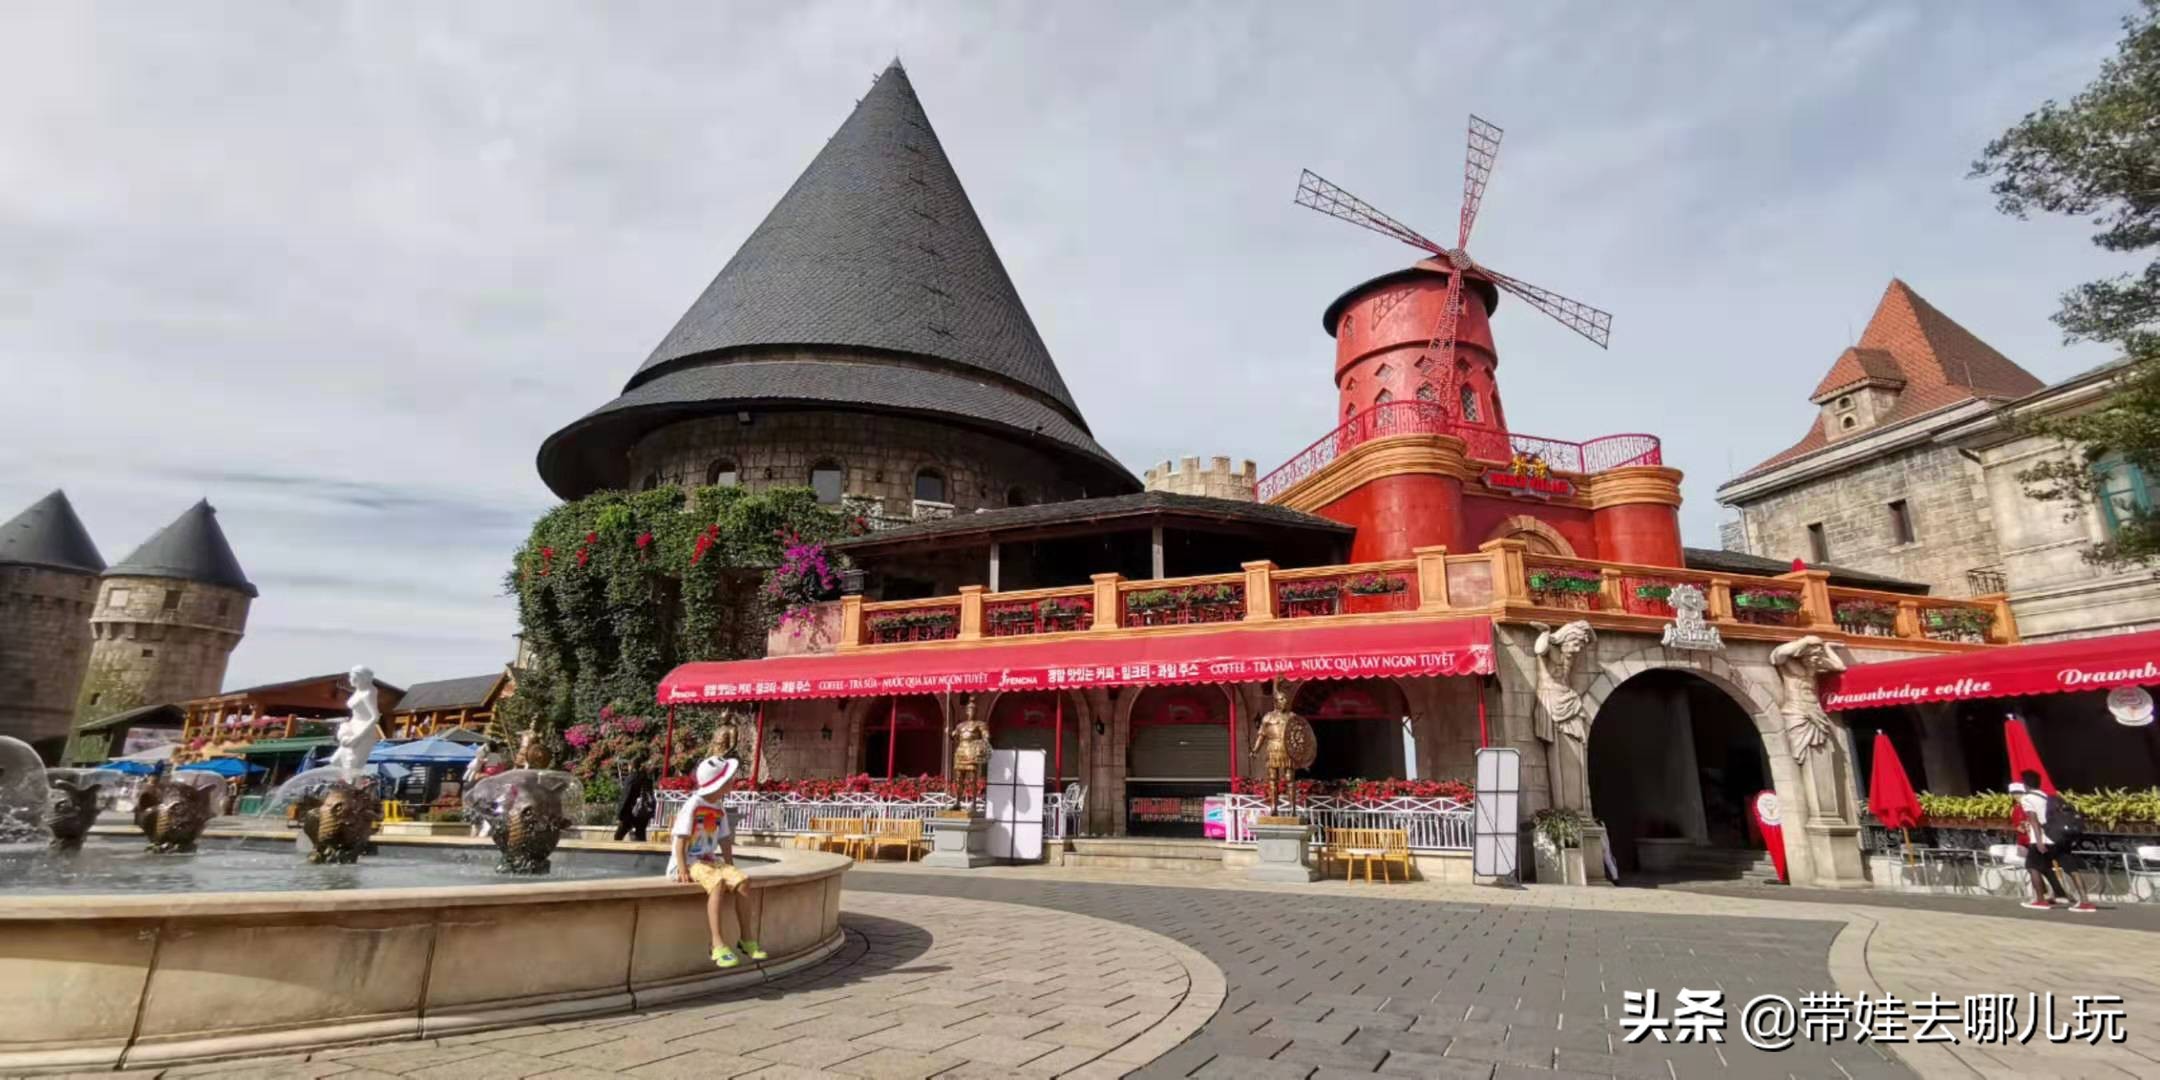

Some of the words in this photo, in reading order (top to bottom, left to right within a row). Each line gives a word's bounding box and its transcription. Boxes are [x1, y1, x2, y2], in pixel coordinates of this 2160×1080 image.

[1179, 663, 1200, 678] 주스
[1210, 661, 1246, 675] COFFEE
[1360, 655, 1380, 669] XAY
[1382, 655, 1417, 668] NGON
[1934, 678, 1992, 697] coffee
